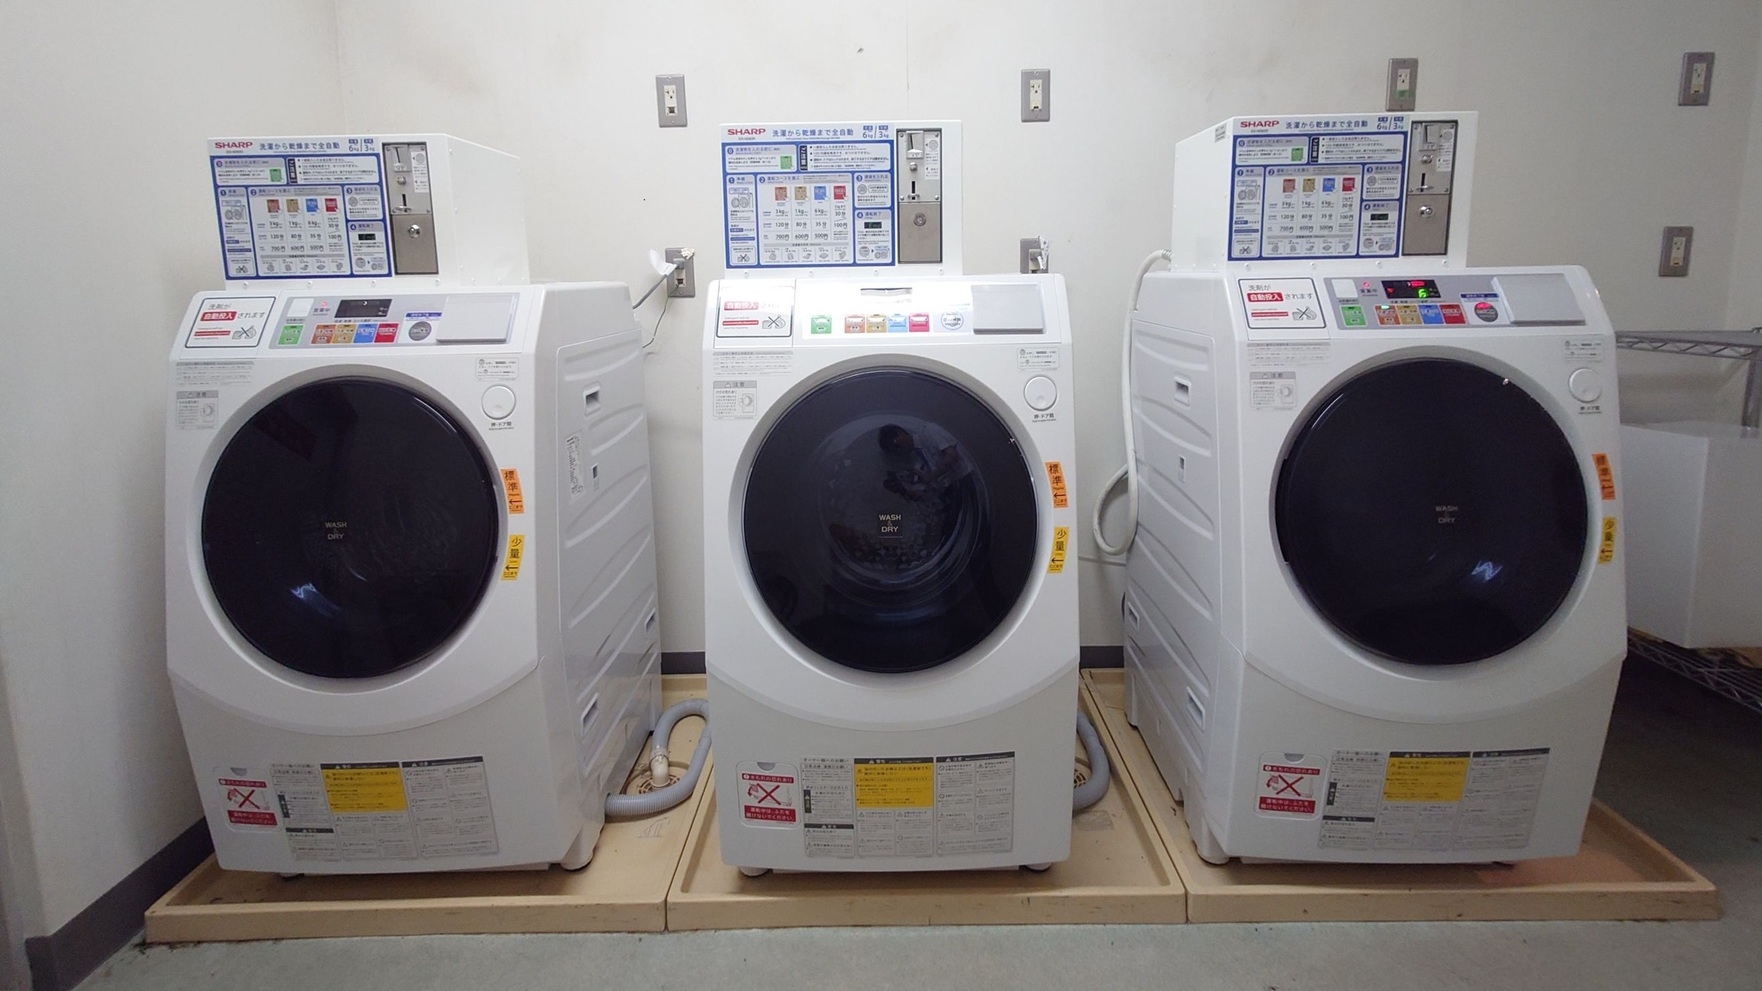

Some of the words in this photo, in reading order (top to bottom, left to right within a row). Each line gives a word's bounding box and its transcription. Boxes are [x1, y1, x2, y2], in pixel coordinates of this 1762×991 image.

[1240, 120, 1280, 129] SHARP
[1285, 120, 1369, 130] 洗濯から乾燥まで全自動
[727, 128, 766, 136] SHARP
[772, 128, 854, 137] 洗濯から乾燥まで全自動
[214, 141, 253, 149] SHARP
[260, 142, 340, 151] 洗濯から乾燥まで全自動
[1055, 529, 1067, 552] 少量
[510, 536, 522, 559] 少量
